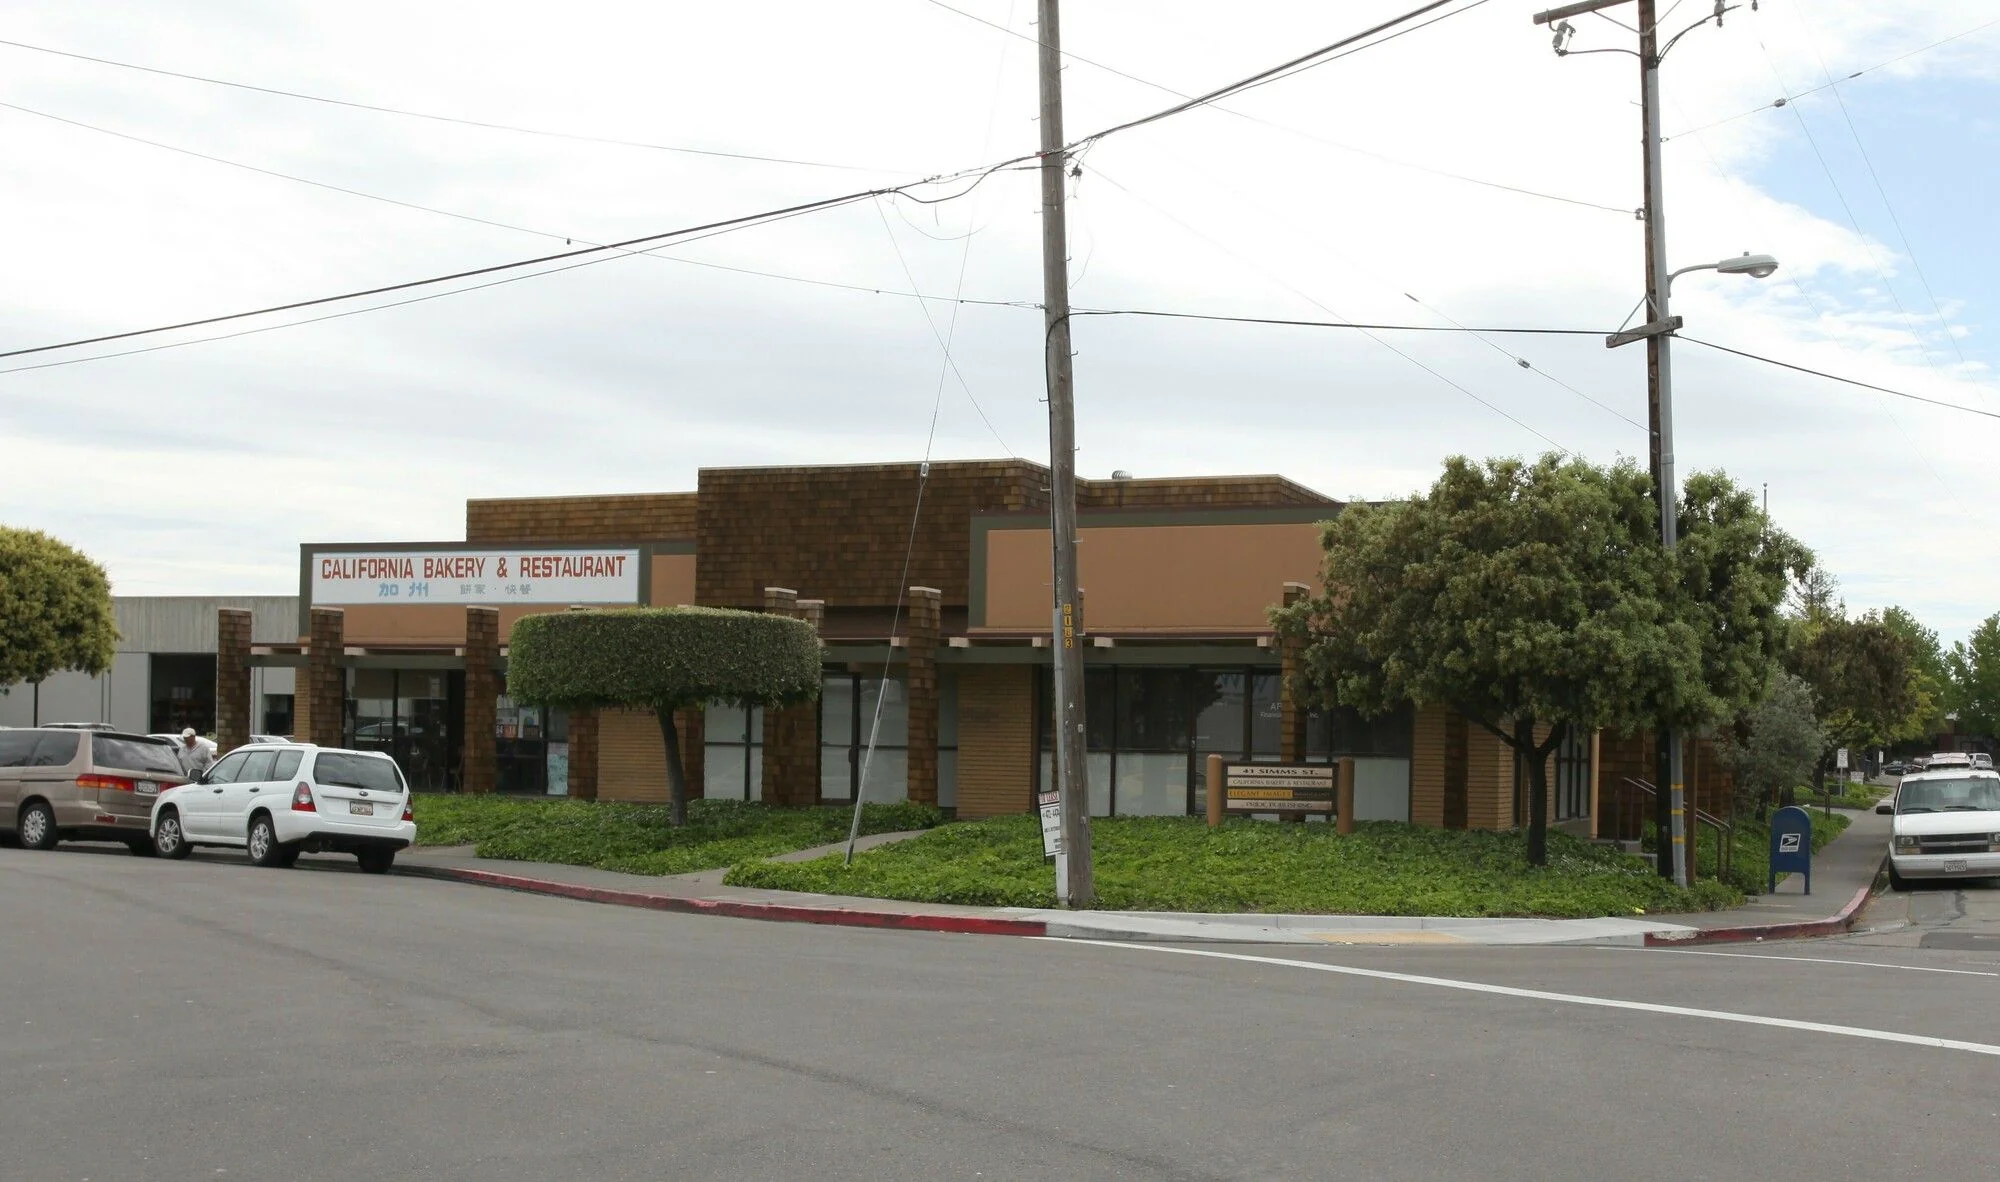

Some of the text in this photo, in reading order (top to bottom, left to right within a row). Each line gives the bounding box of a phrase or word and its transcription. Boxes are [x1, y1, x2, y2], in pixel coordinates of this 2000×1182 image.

[322, 556, 626, 579] CALIFORNIA BAKERY & RESTAURANT
